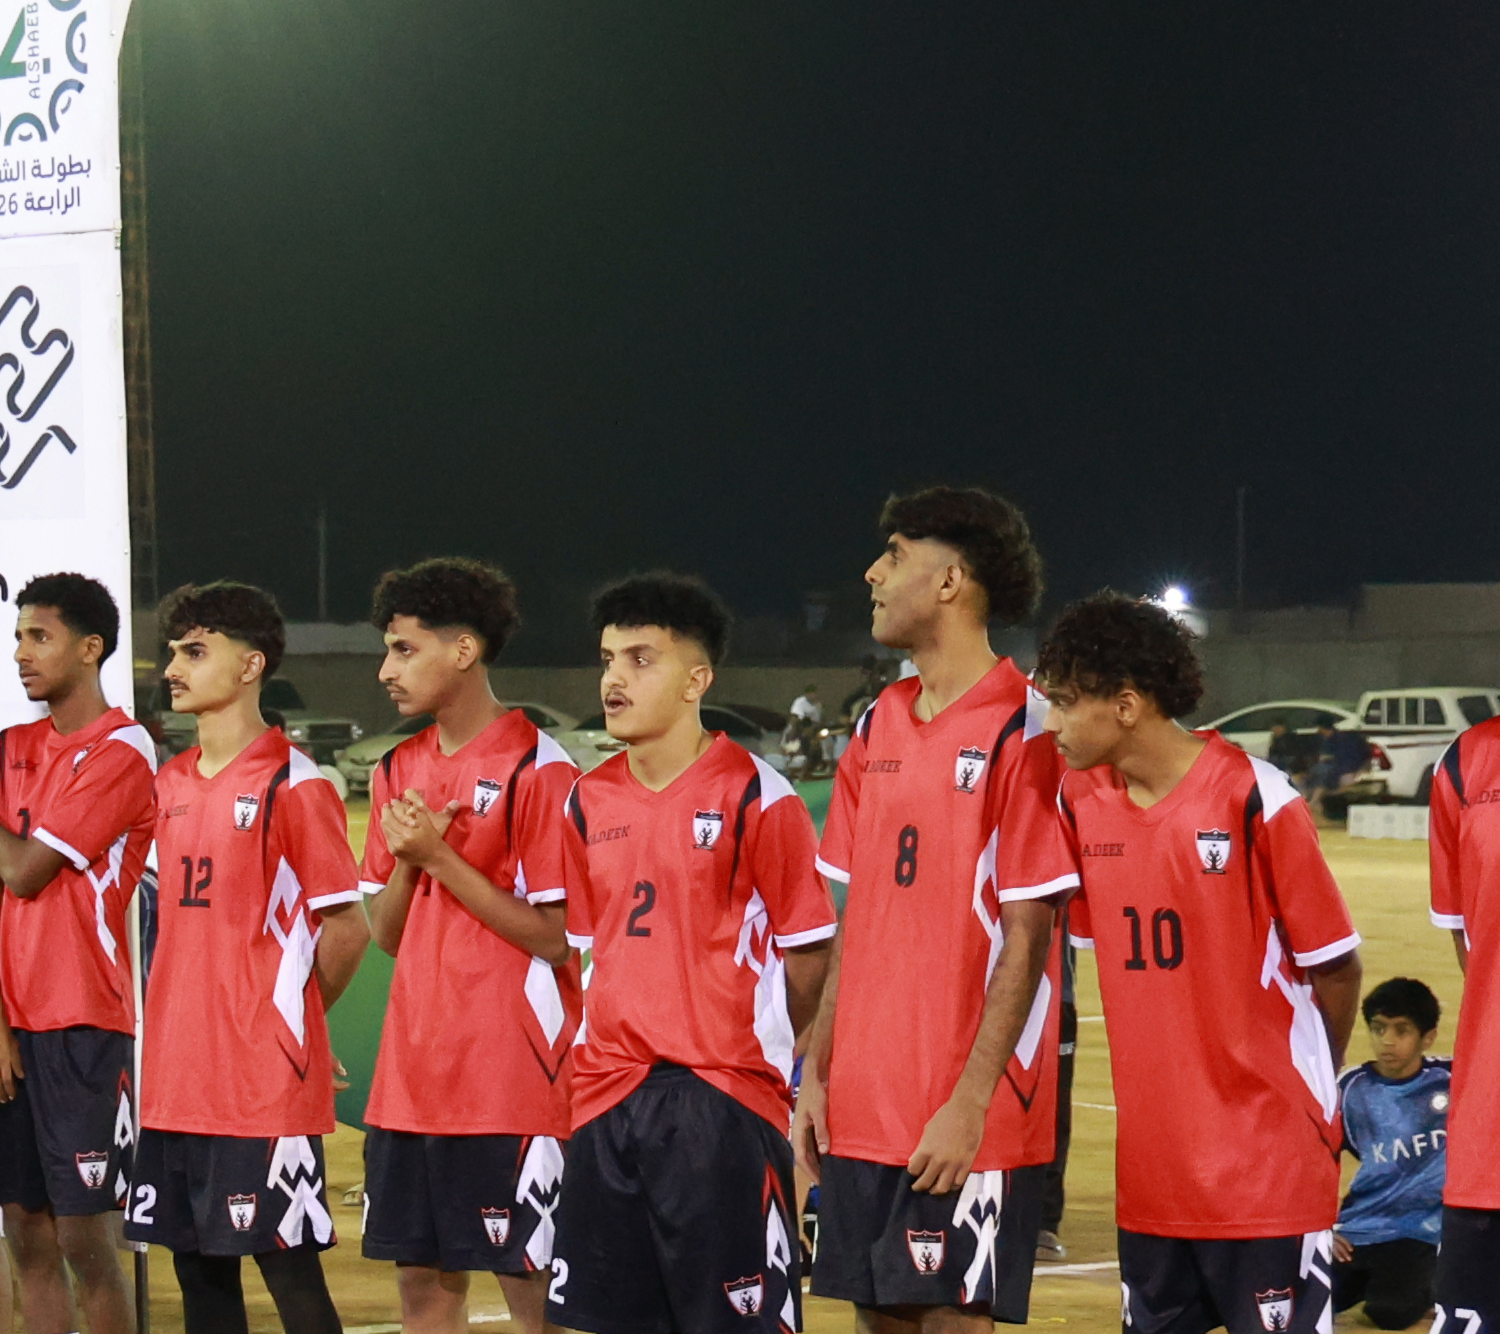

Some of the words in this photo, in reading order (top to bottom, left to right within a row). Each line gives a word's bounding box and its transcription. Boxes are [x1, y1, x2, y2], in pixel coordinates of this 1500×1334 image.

[26, 1, 41, 99] ALSHAEB
[31, 154, 91, 182] بطولة
[24, 186, 80, 215] الرابعة
[895, 824, 918, 888] 8
[1082, 843, 1125, 857] ADEEK
[178, 855, 214, 908] 12
[625, 880, 656, 937] 2
[1123, 906, 1184, 971] 10
[548, 1258, 569, 1305] 2
